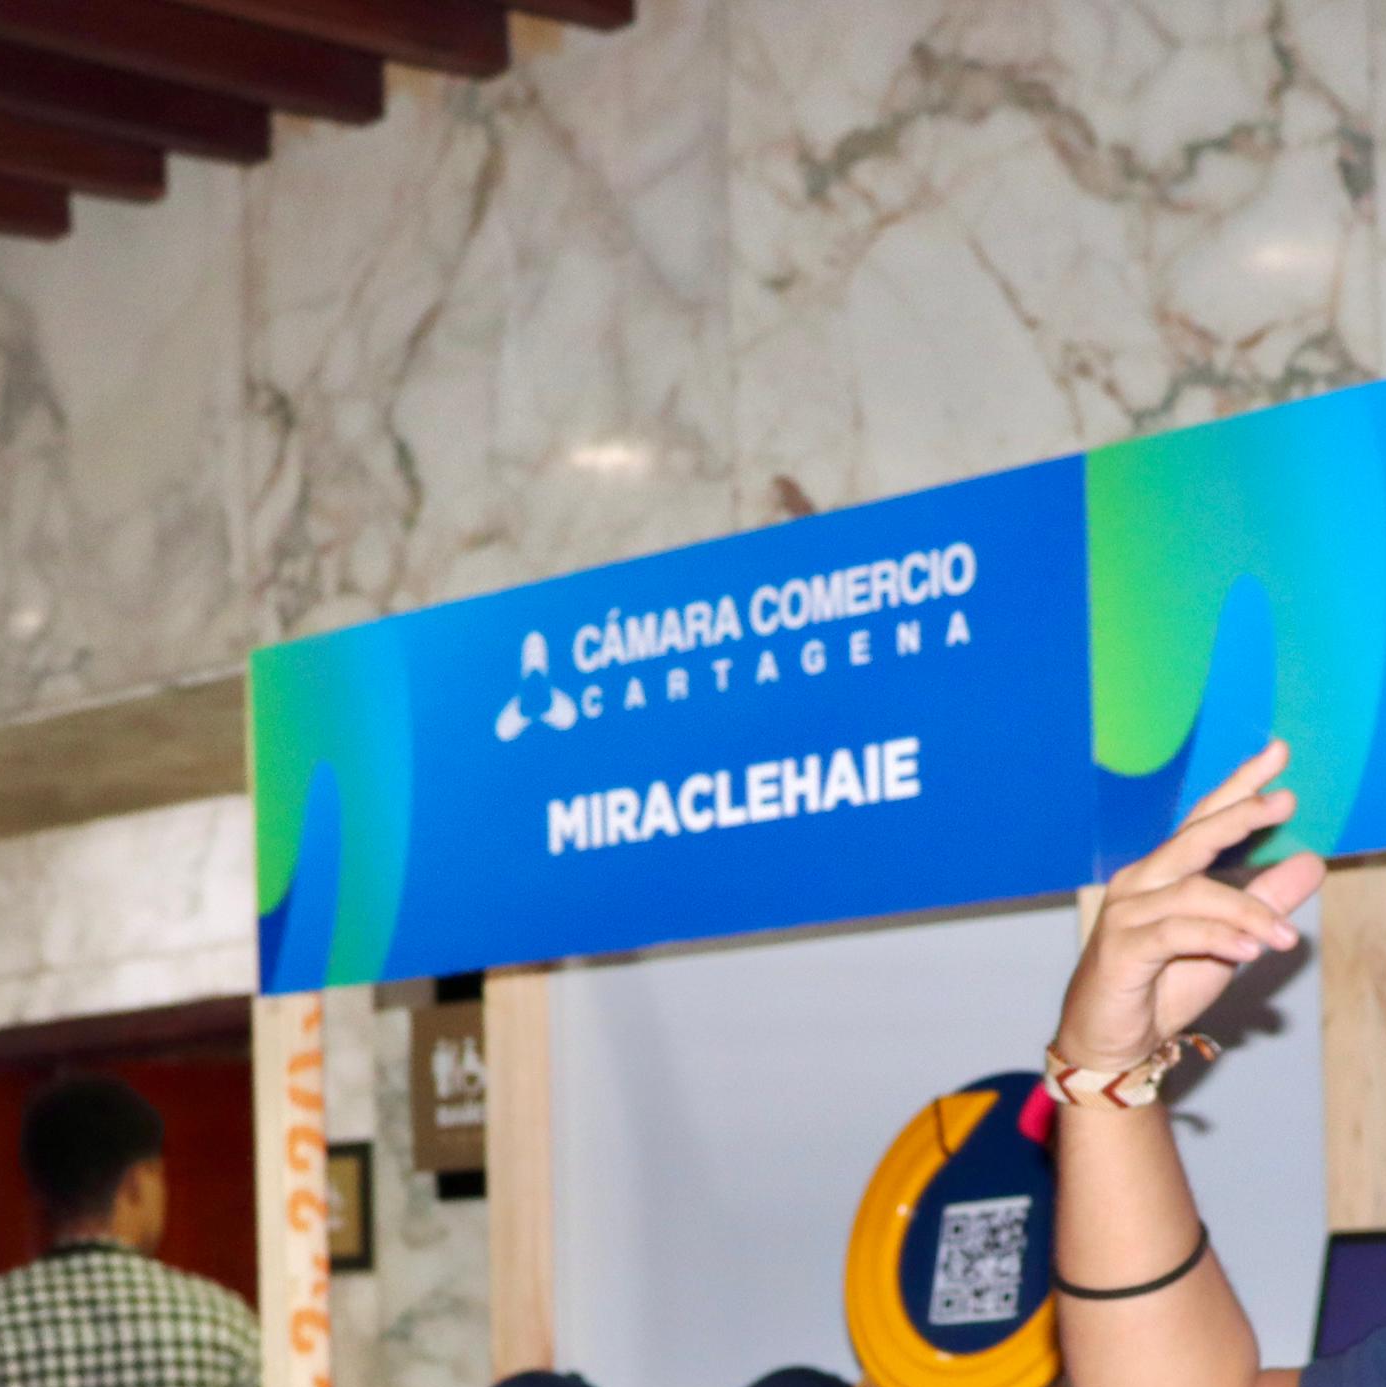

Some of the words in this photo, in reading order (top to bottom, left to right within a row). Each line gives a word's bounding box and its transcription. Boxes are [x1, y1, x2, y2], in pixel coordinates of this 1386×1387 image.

[573, 595, 742, 674] CÁMARA
[749, 543, 977, 637] COMERCIO
[581, 610, 972, 719] CARTAGENA
[548, 737, 921, 856] MIRACLEHAIE
